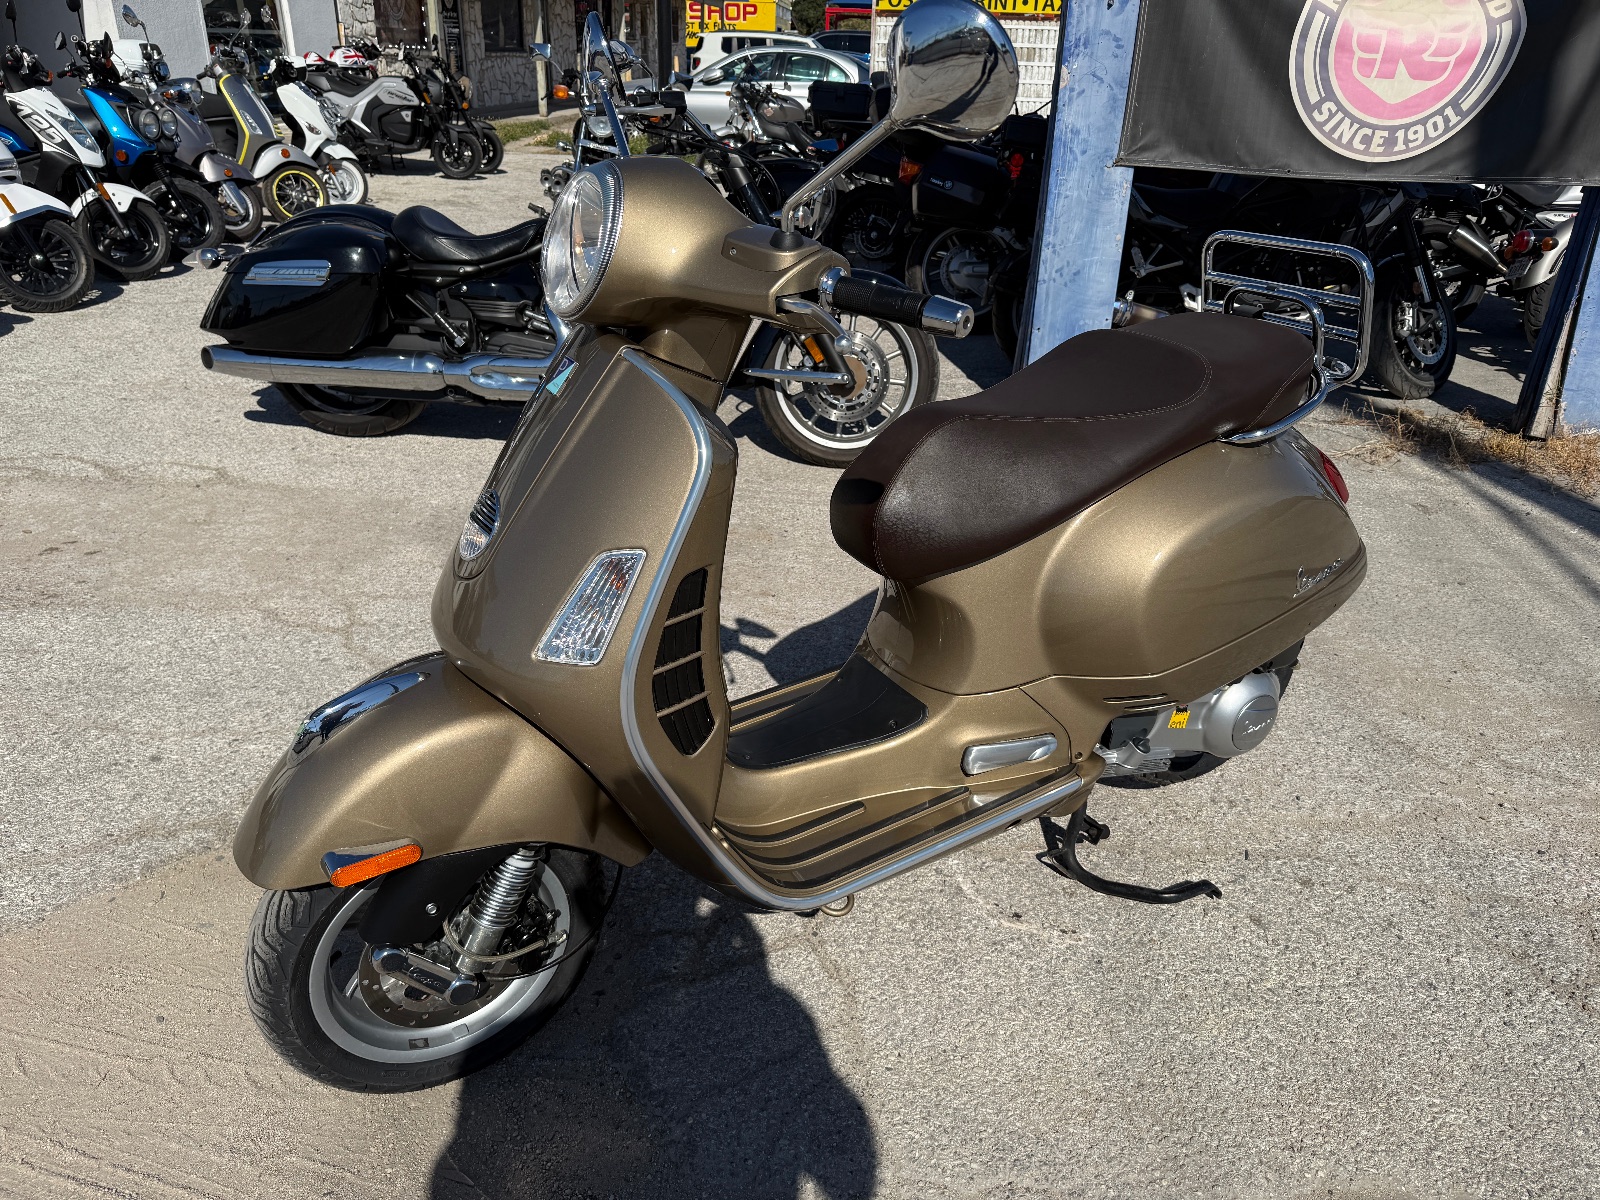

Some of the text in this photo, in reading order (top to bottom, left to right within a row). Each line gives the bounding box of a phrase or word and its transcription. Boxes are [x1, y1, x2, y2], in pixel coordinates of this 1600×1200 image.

[689, 2, 757, 21] SHOP
[17, 104, 65, 143] 125
[1312, 101, 1461, 153] SINCE 1901
